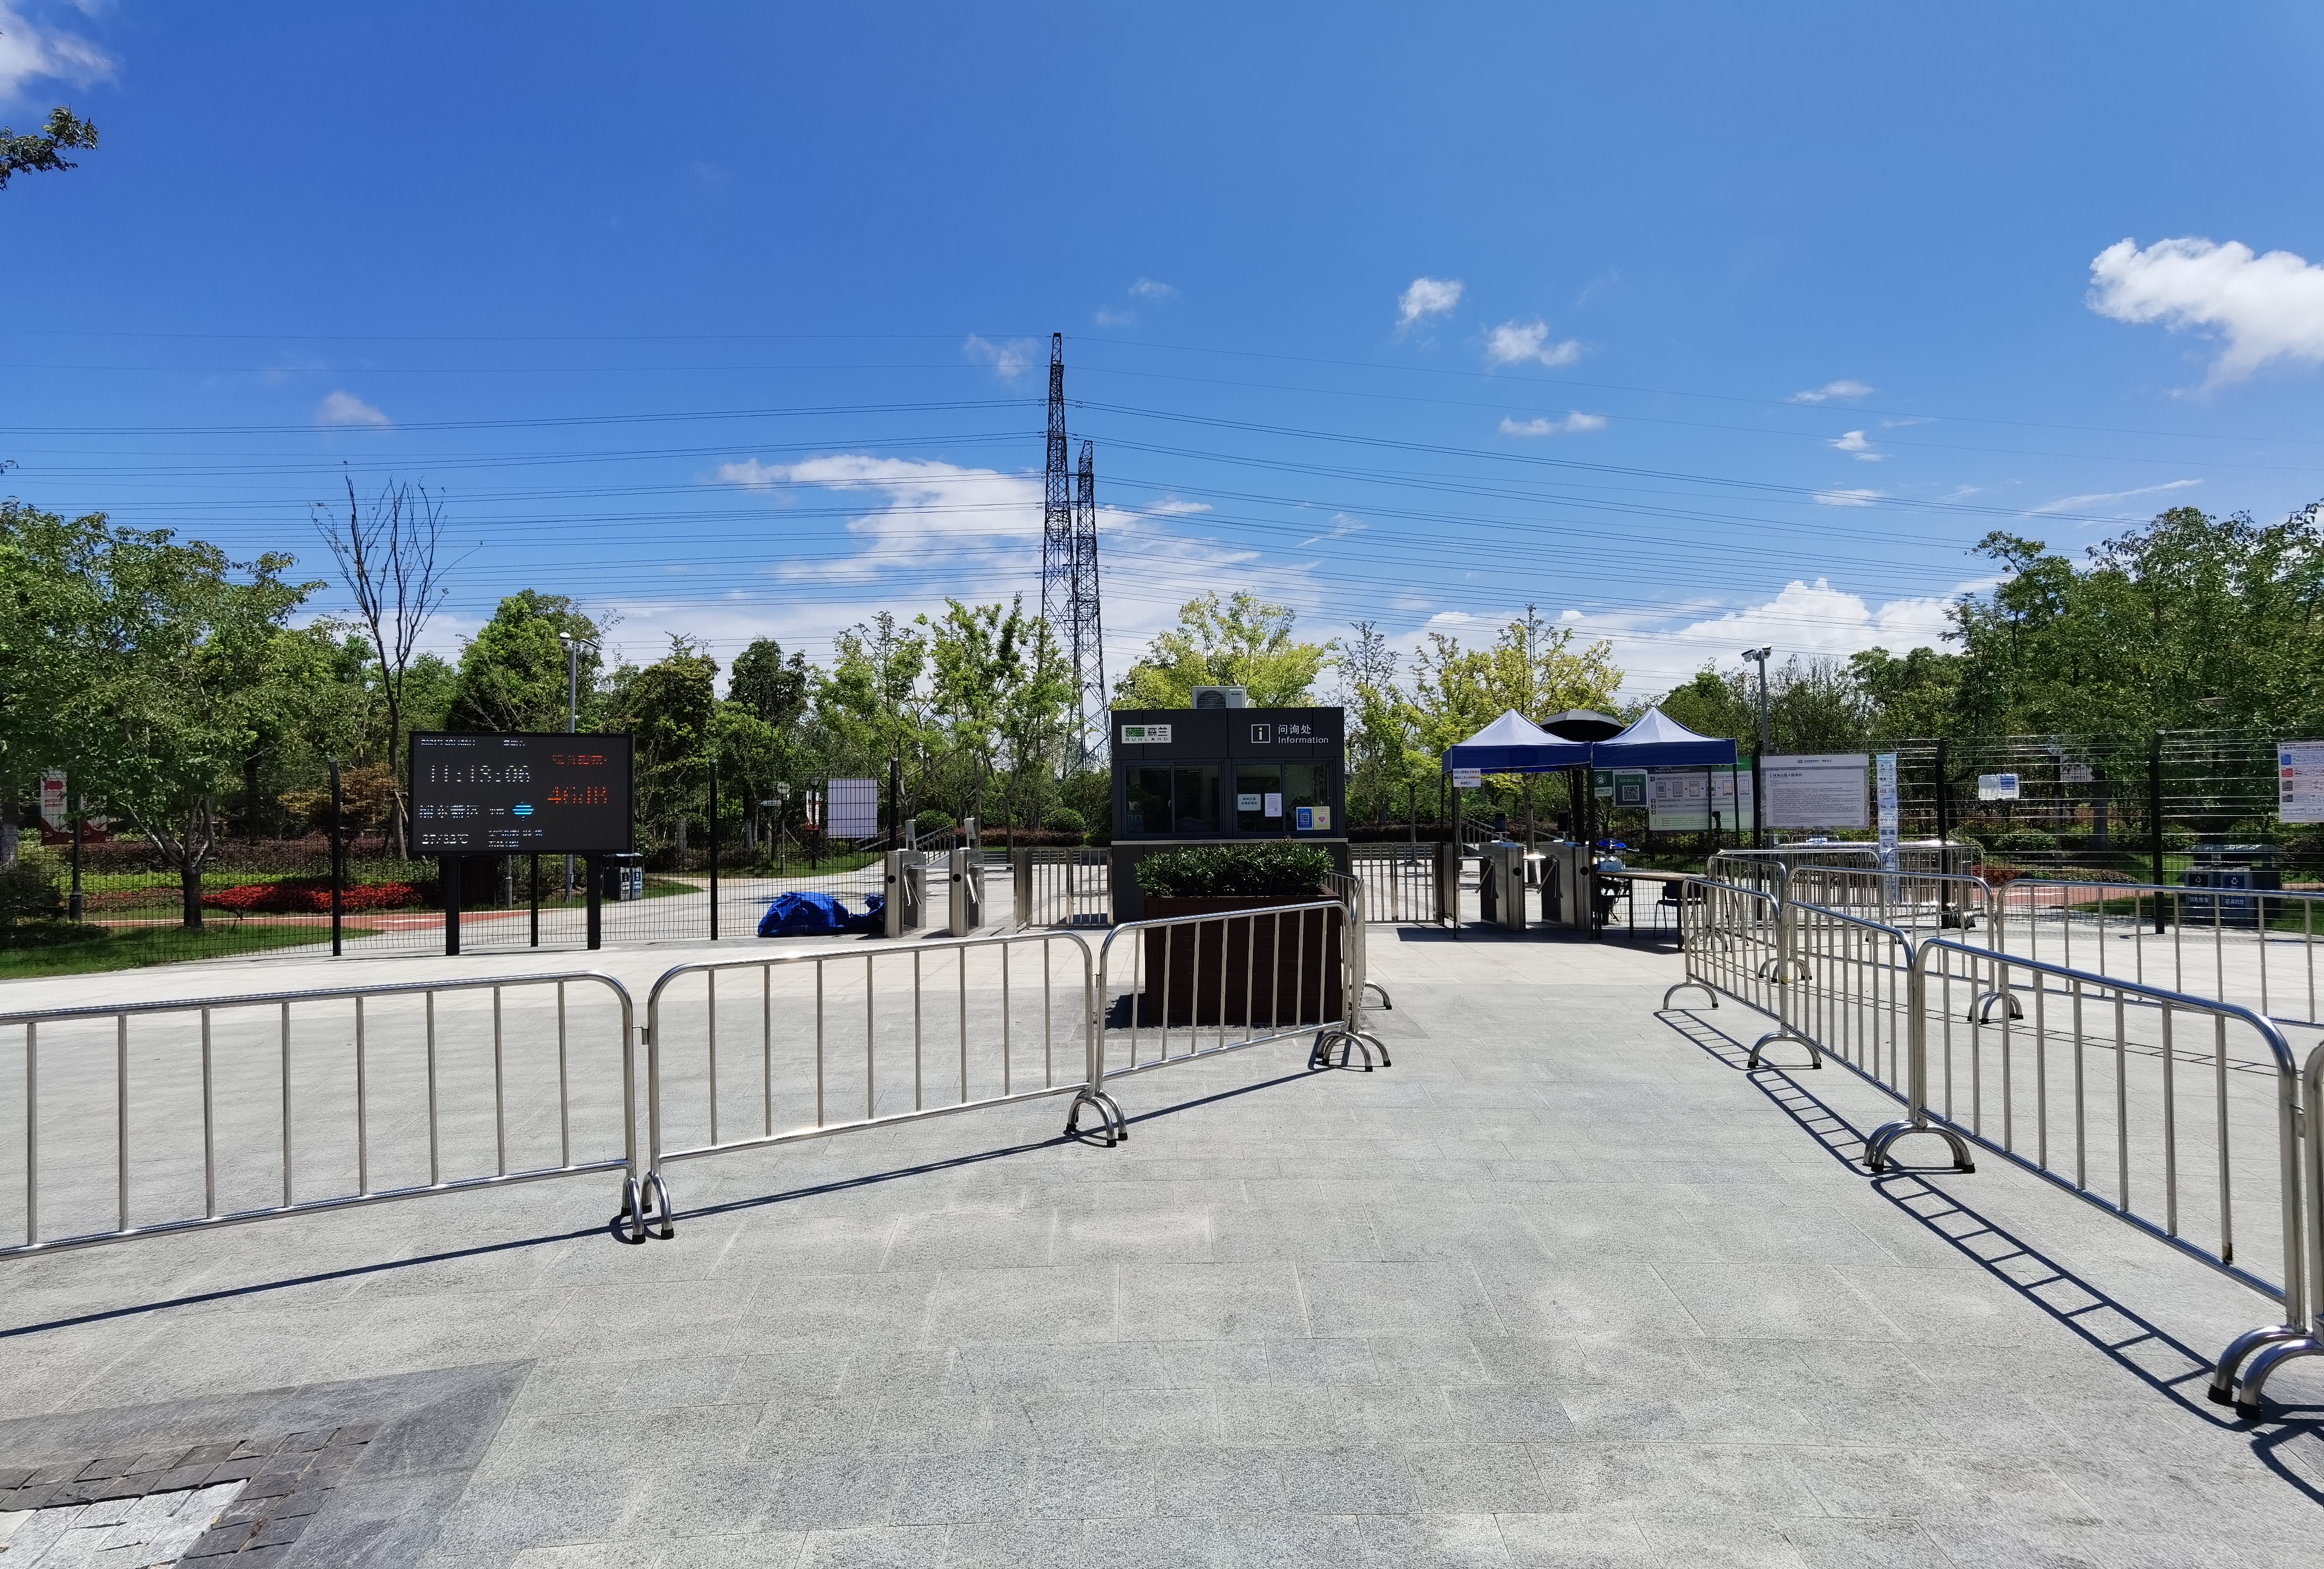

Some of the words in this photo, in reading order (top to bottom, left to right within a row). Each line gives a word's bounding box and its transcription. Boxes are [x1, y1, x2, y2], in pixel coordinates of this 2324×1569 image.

[1147, 726, 1168, 737] 森兰
[1278, 724, 1311, 734] 问询处
